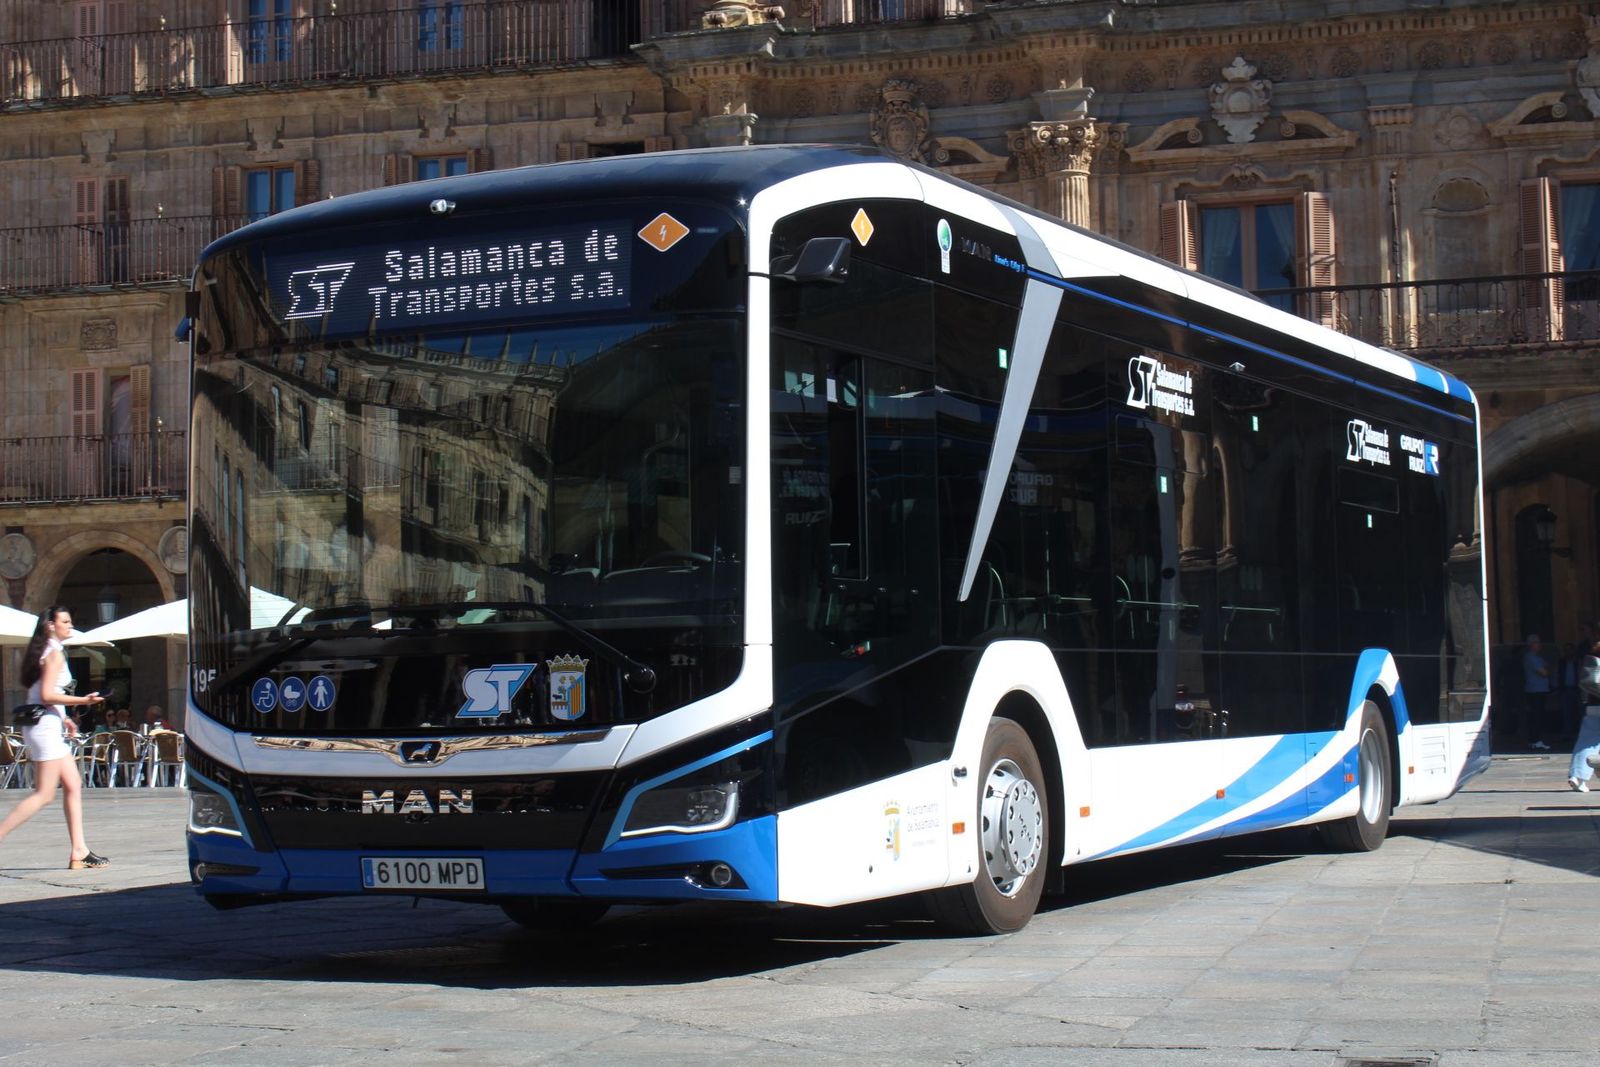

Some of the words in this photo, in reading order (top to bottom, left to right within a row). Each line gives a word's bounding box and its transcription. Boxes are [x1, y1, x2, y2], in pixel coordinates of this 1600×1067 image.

[386, 239, 565, 282] Salamanca
[584, 229, 618, 262] de
[368, 273, 556, 319] Transportes
[571, 271, 624, 300] s.a.
[1400, 435, 1424, 455] GRUPO
[1408, 455, 1425, 474] RUIZ
[458, 666, 534, 717] ST
[362, 789, 474, 814] MAN
[377, 862, 432, 884] 6100
[438, 862, 479, 885] MPD
